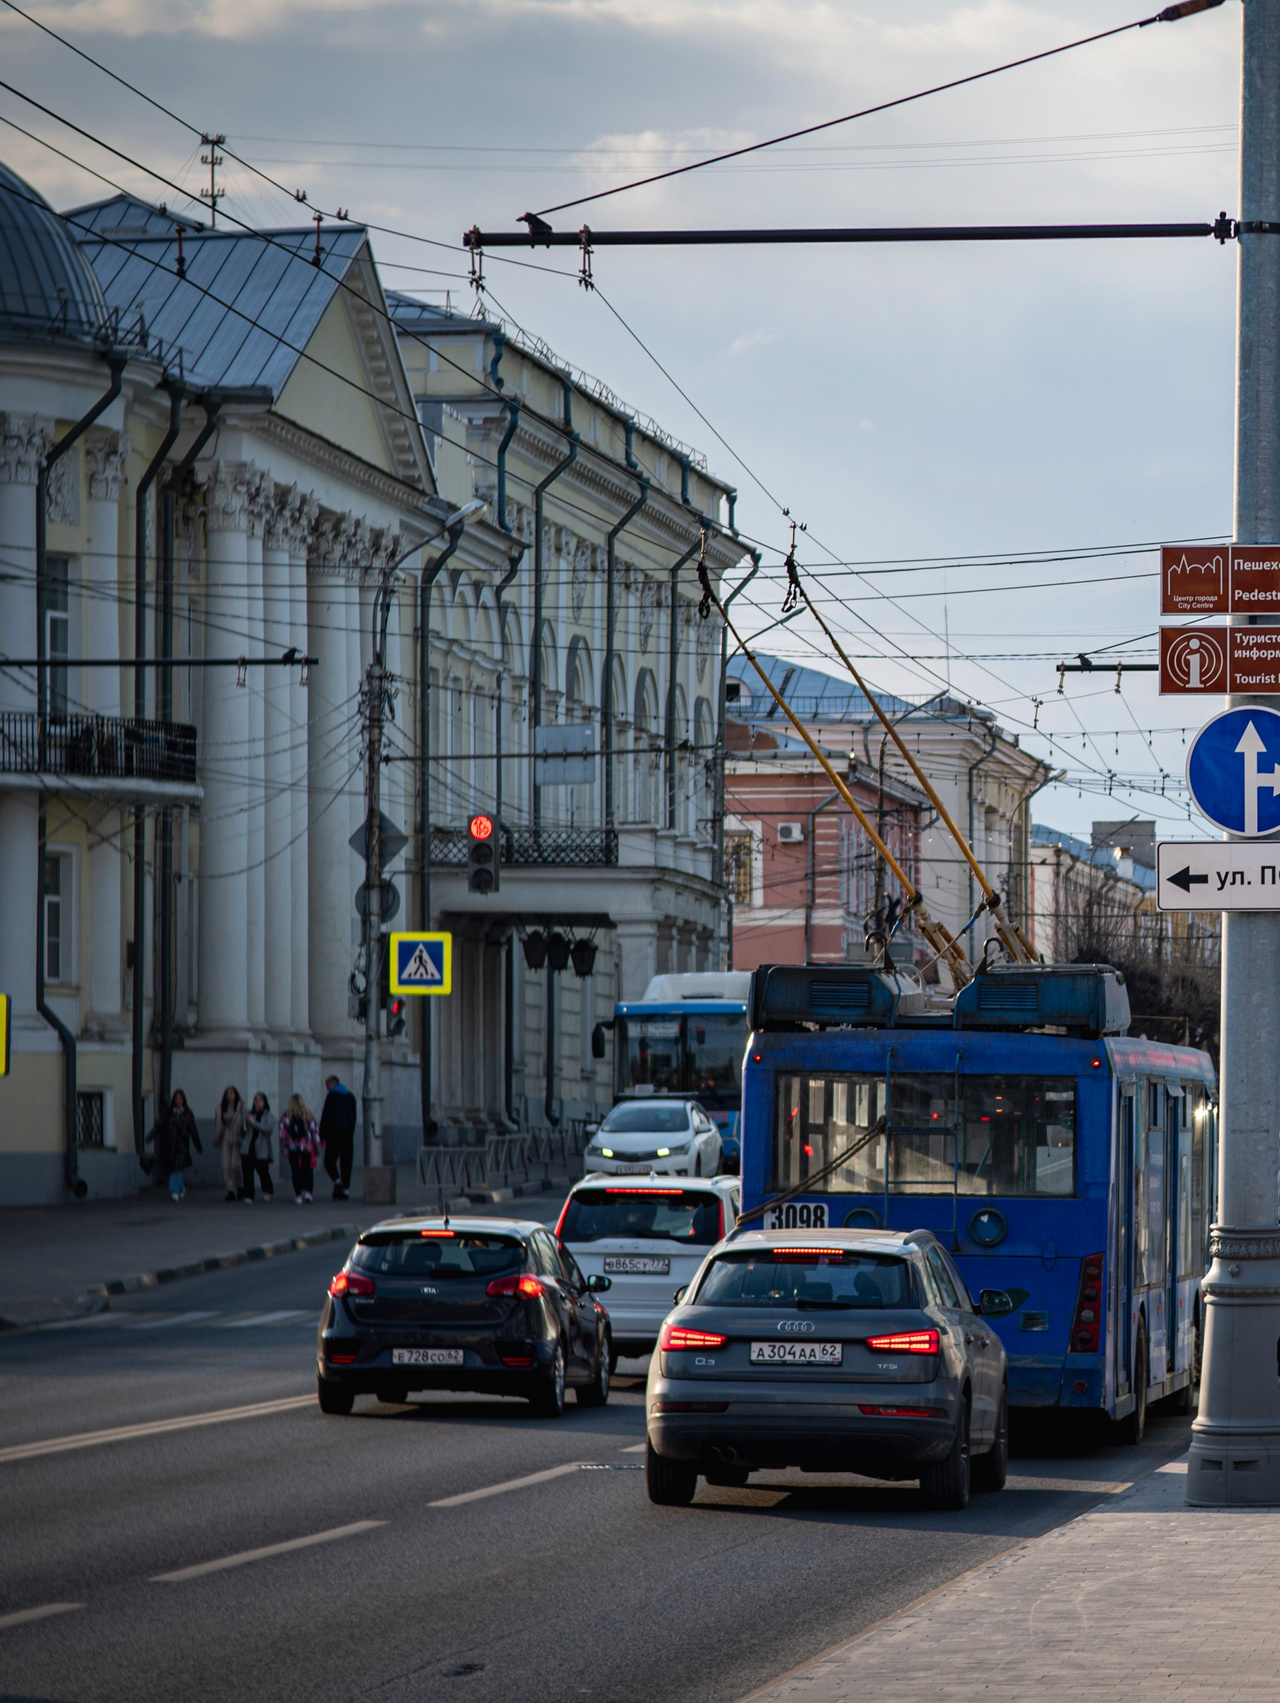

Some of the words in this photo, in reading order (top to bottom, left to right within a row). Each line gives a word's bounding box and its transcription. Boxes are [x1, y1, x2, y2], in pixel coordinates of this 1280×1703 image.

[1178, 602, 1191, 610] City
[1235, 673, 1275, 684] Tourist
[1216, 871, 1252, 891] ул.
[770, 1203, 825, 1229] 3098
[821, 1344, 837, 1356] 62
[695, 1357, 716, 1366] Q3
